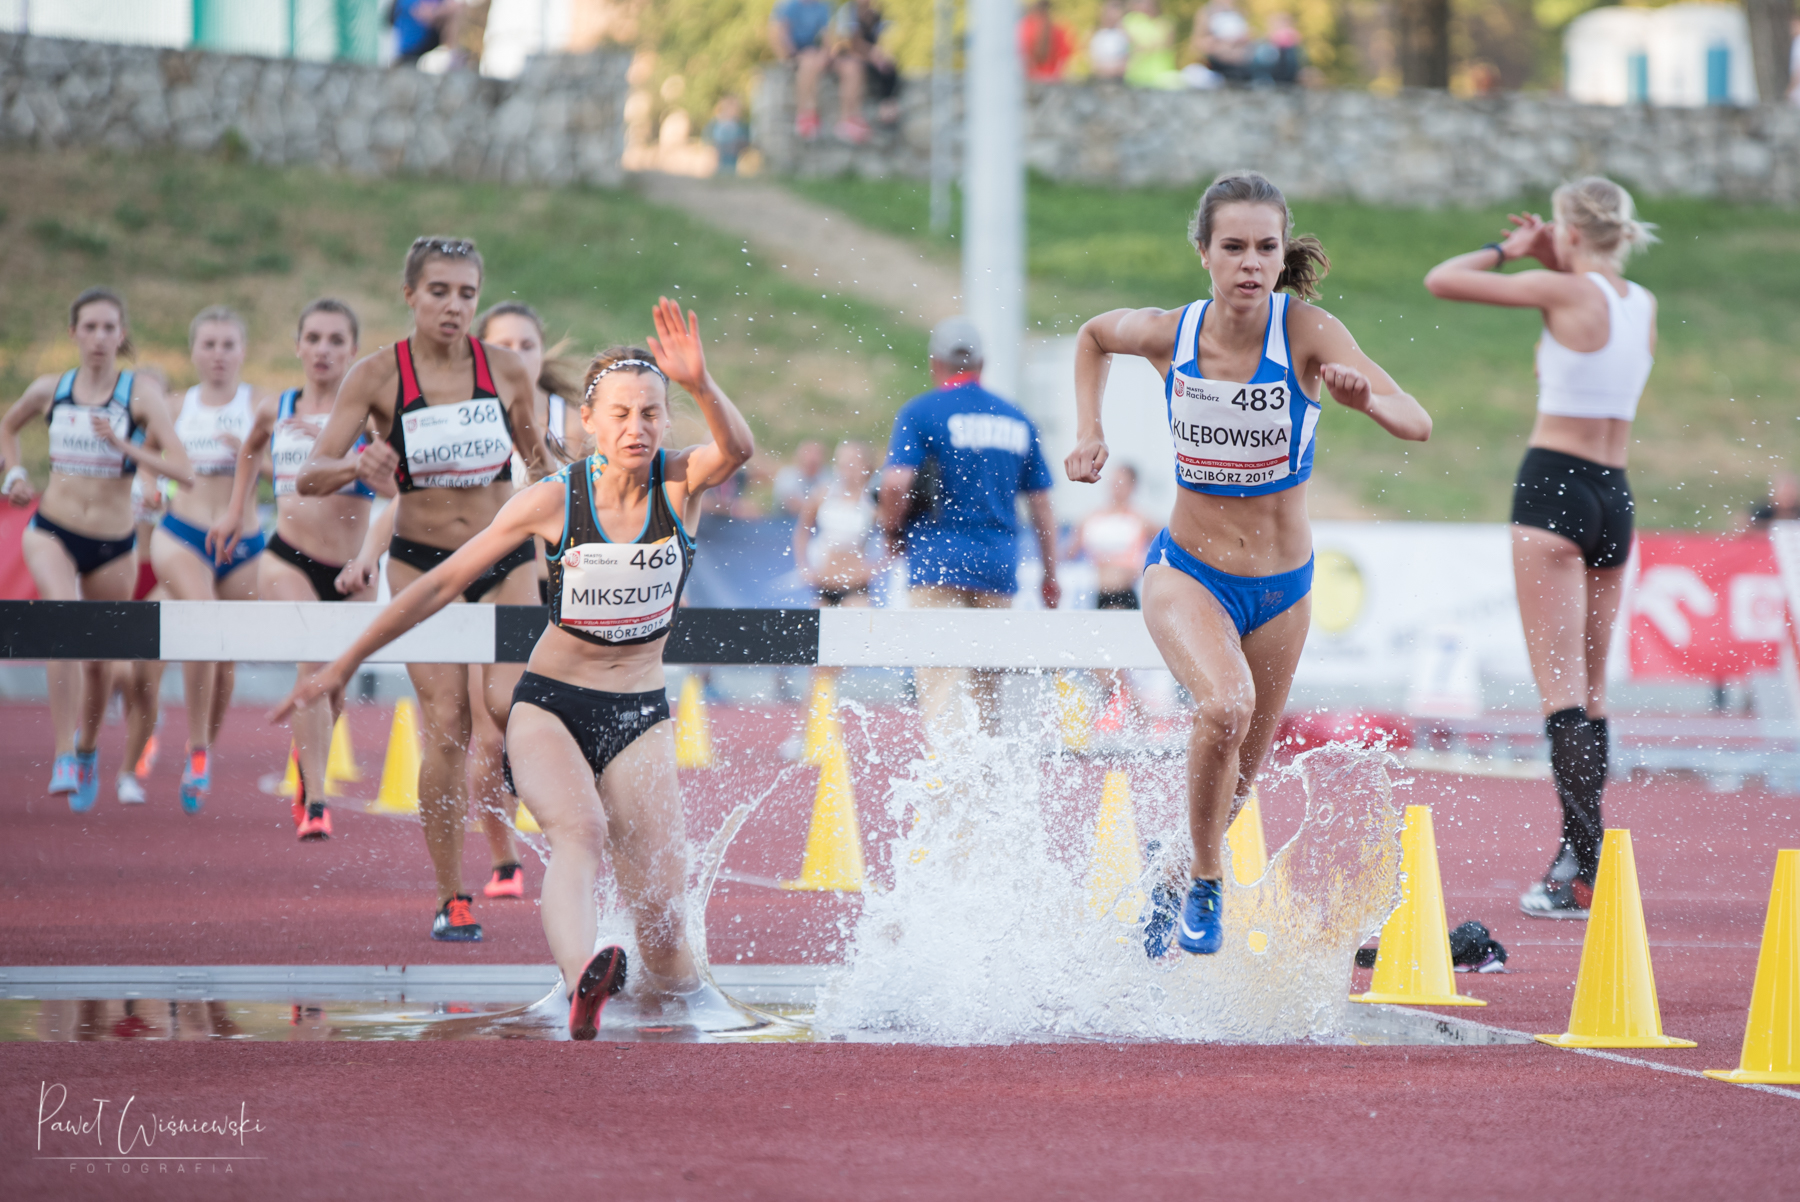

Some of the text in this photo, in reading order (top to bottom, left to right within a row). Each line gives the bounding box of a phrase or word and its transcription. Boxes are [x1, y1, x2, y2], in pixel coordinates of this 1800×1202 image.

[1186, 390, 1220, 402] Racibórz
[1231, 386, 1285, 411] 483
[458, 404, 498, 426] 368
[1173, 417, 1288, 448] KLĘBOWSKA
[412, 438, 507, 464] CHORZĘPA
[1185, 457, 1200, 465] PZLA
[1201, 460, 1244, 468] MISTRZOSTWA
[1180, 466, 1275, 483] RACIBÓRZ 2019
[630, 544, 677, 571] 468
[571, 581, 673, 606] MIKSZUTA
